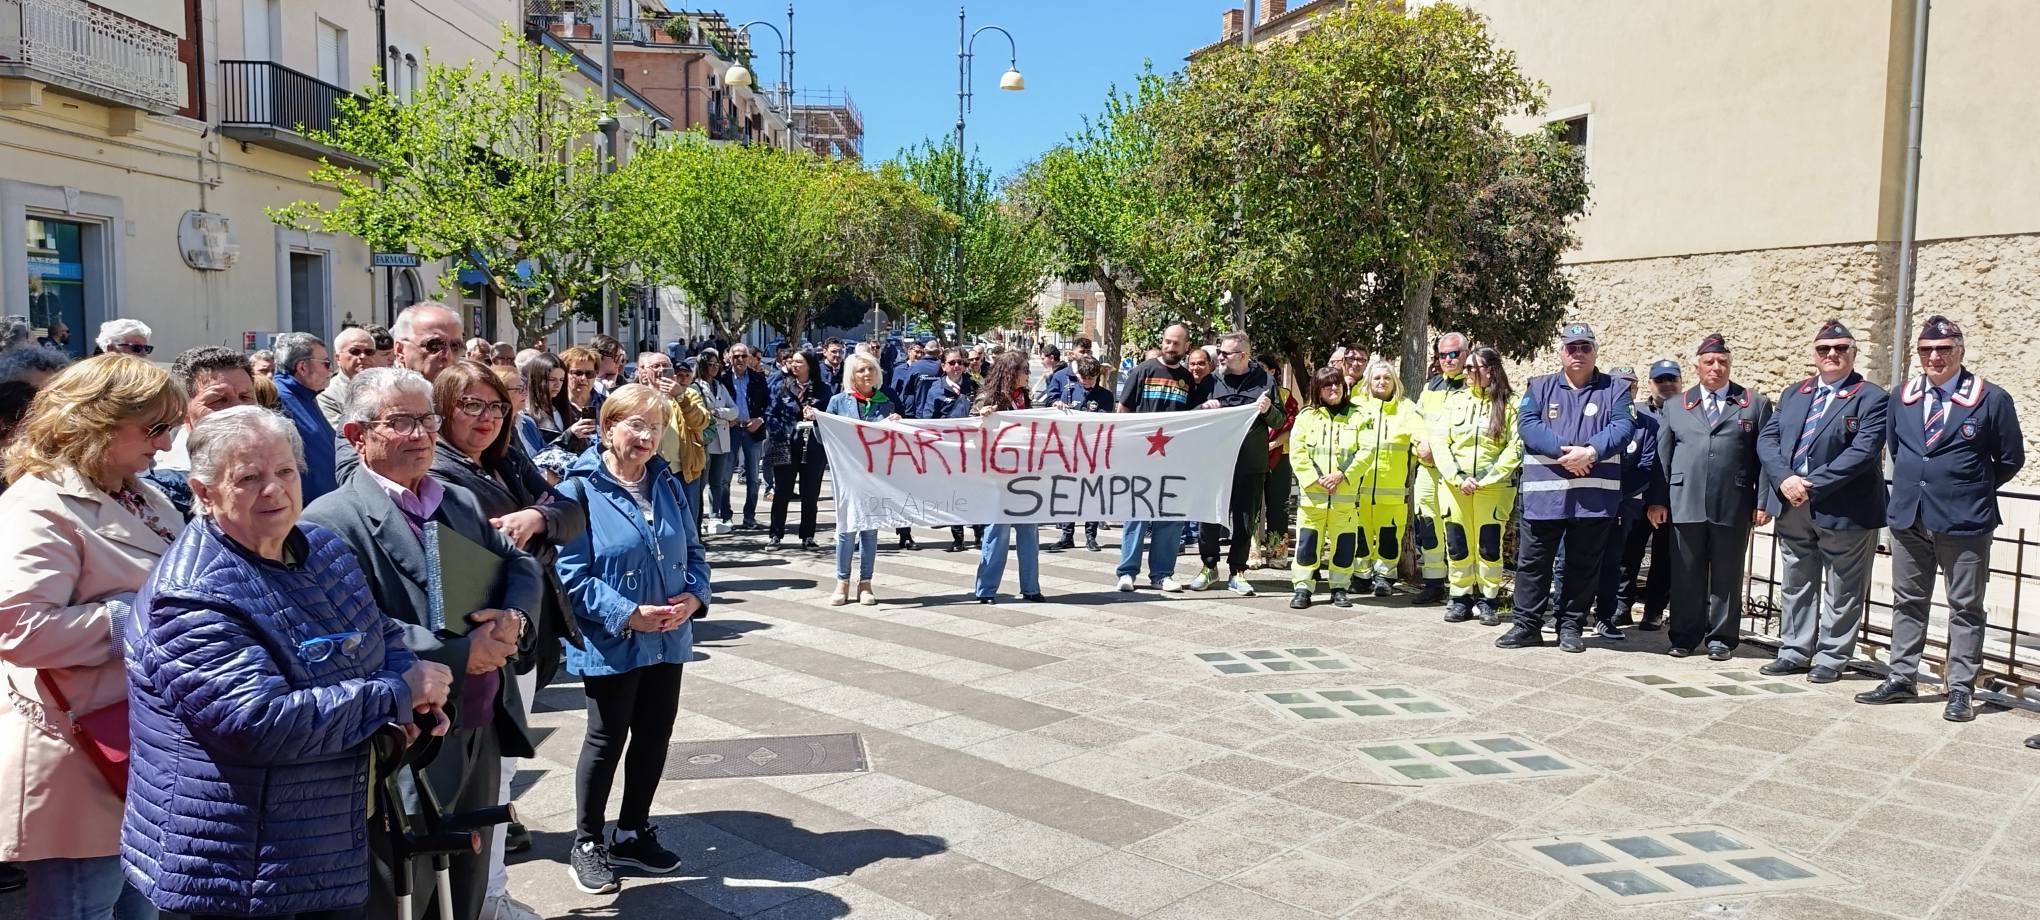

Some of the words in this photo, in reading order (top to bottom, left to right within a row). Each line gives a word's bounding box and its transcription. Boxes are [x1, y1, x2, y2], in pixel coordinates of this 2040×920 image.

[376, 255, 414, 264] FARMACIA
[856, 421, 1114, 475] PARTIGIANI
[900, 489, 969, 521] Aprile
[1003, 475, 1187, 518] SEMPRE
